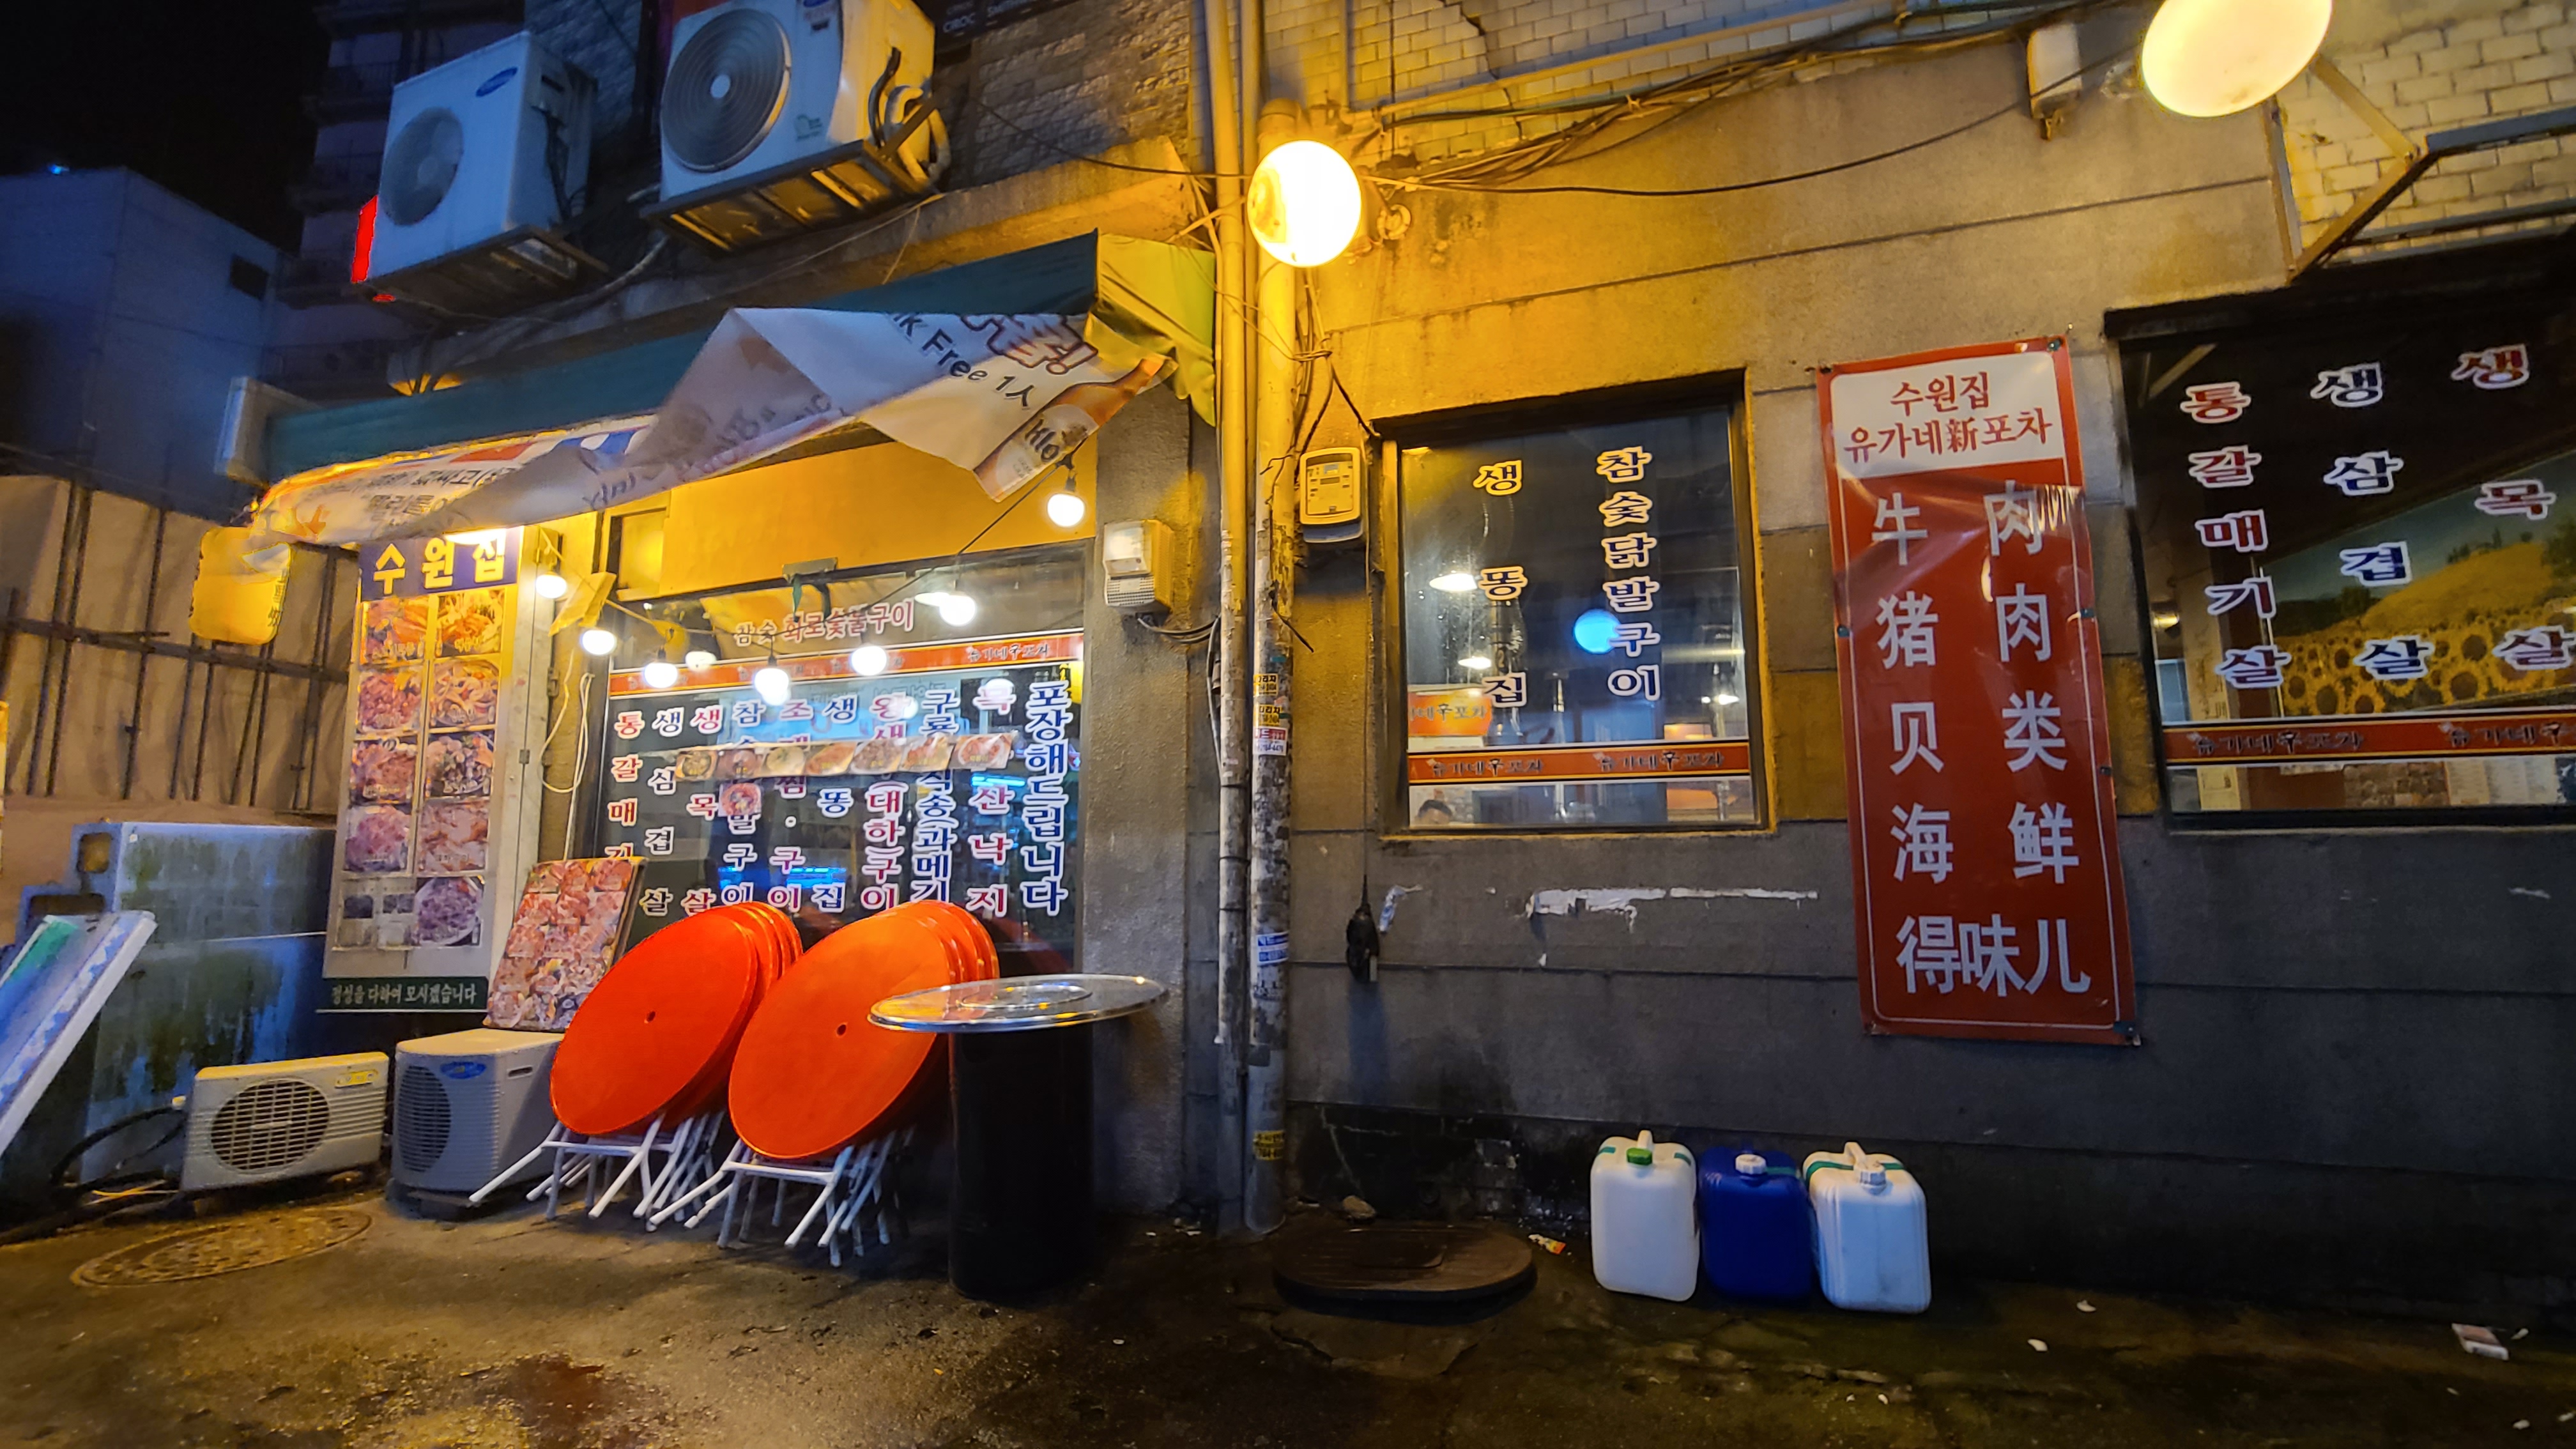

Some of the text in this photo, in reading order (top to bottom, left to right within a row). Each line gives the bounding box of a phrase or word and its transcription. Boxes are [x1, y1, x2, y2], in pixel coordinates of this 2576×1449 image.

[922, 328, 988, 381] Free
[1890, 371, 1989, 417] 수원집
[1844, 407, 2053, 463] 유가네新포차
[2180, 381, 2291, 688] 통갈매기살
[1020, 680, 1073, 916] 포장해드립니다
[1895, 914, 2092, 997] 得味儿
